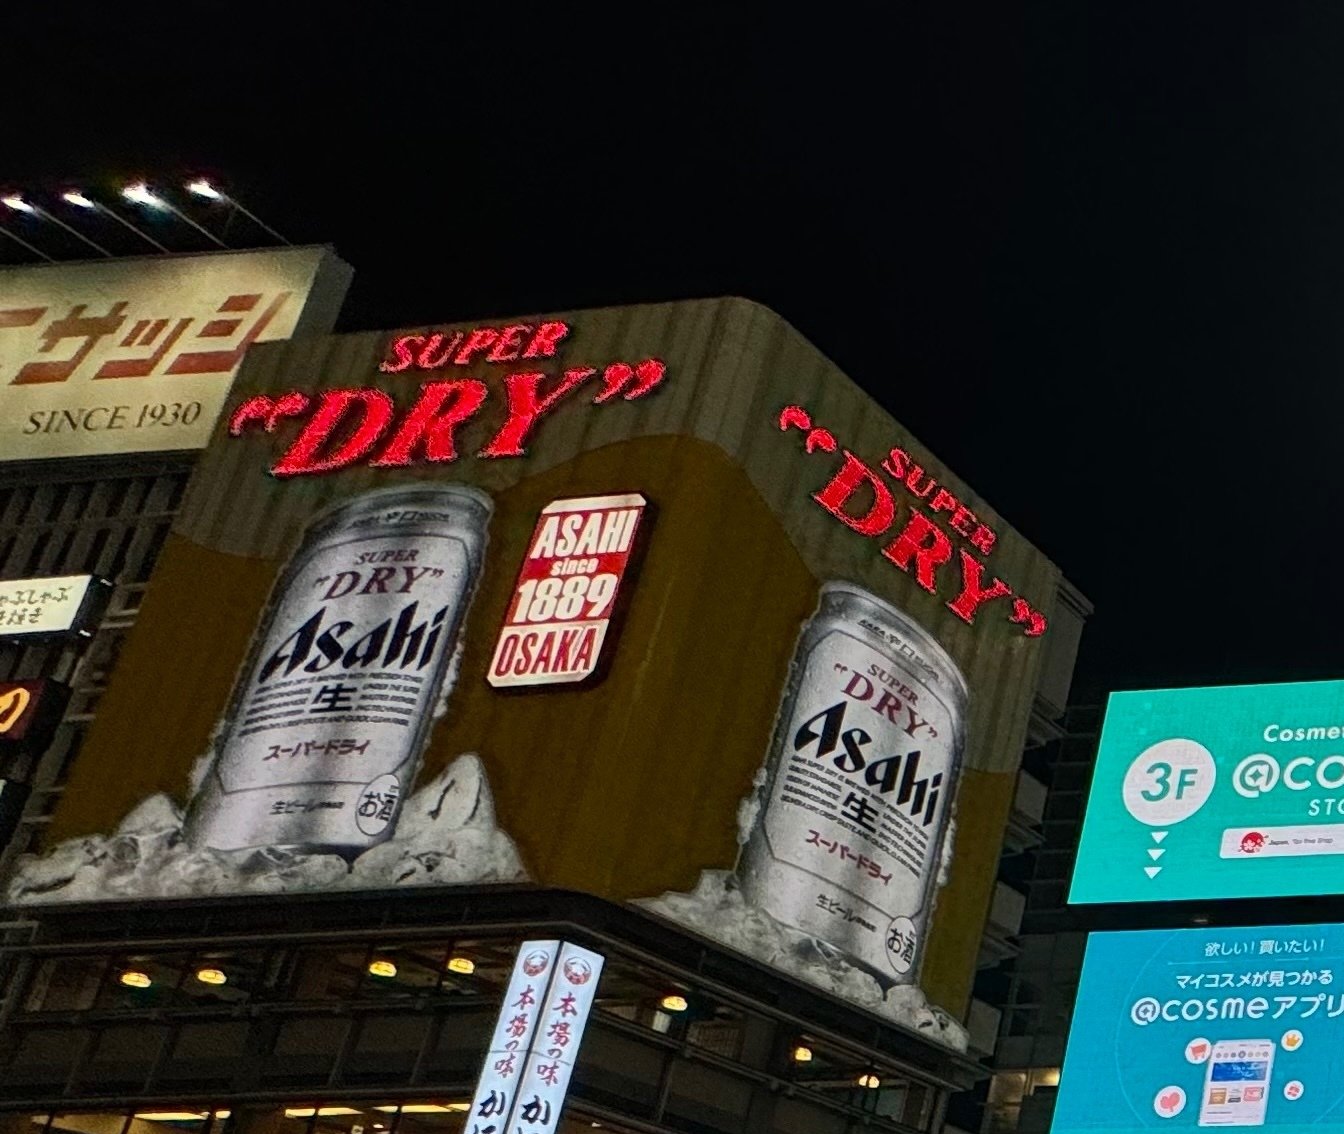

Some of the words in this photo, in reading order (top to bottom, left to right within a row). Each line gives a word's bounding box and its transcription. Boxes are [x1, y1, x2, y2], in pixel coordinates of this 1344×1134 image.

[379, 320, 570, 373] SUPER
[23, 406, 128, 434] SINCE
[136, 400, 201, 428] 1930
[881, 446, 998, 556] SUPER
[354, 549, 420, 565] SUPER
[529, 510, 639, 560] ASAHI
[549, 556, 599, 577] since
[511, 573, 617, 624] 1889
[259, 600, 448, 684] Asahi
[497, 624, 598, 680] OSAKA
[309, 683, 357, 713] 生
[867, 663, 919, 706] SUPER
[263, 739, 371, 761] スーパードライ
[794, 701, 943, 827] Asahi
[1141, 762, 1198, 802] 3F
[841, 792, 879, 834] 生
[805, 829, 892, 886] スーパードライ
[1175, 970, 1334, 990] マイコスメが見つかる
[494, 984, 536, 1079] 本場の味
[536, 992, 578, 1088] 本場の味
